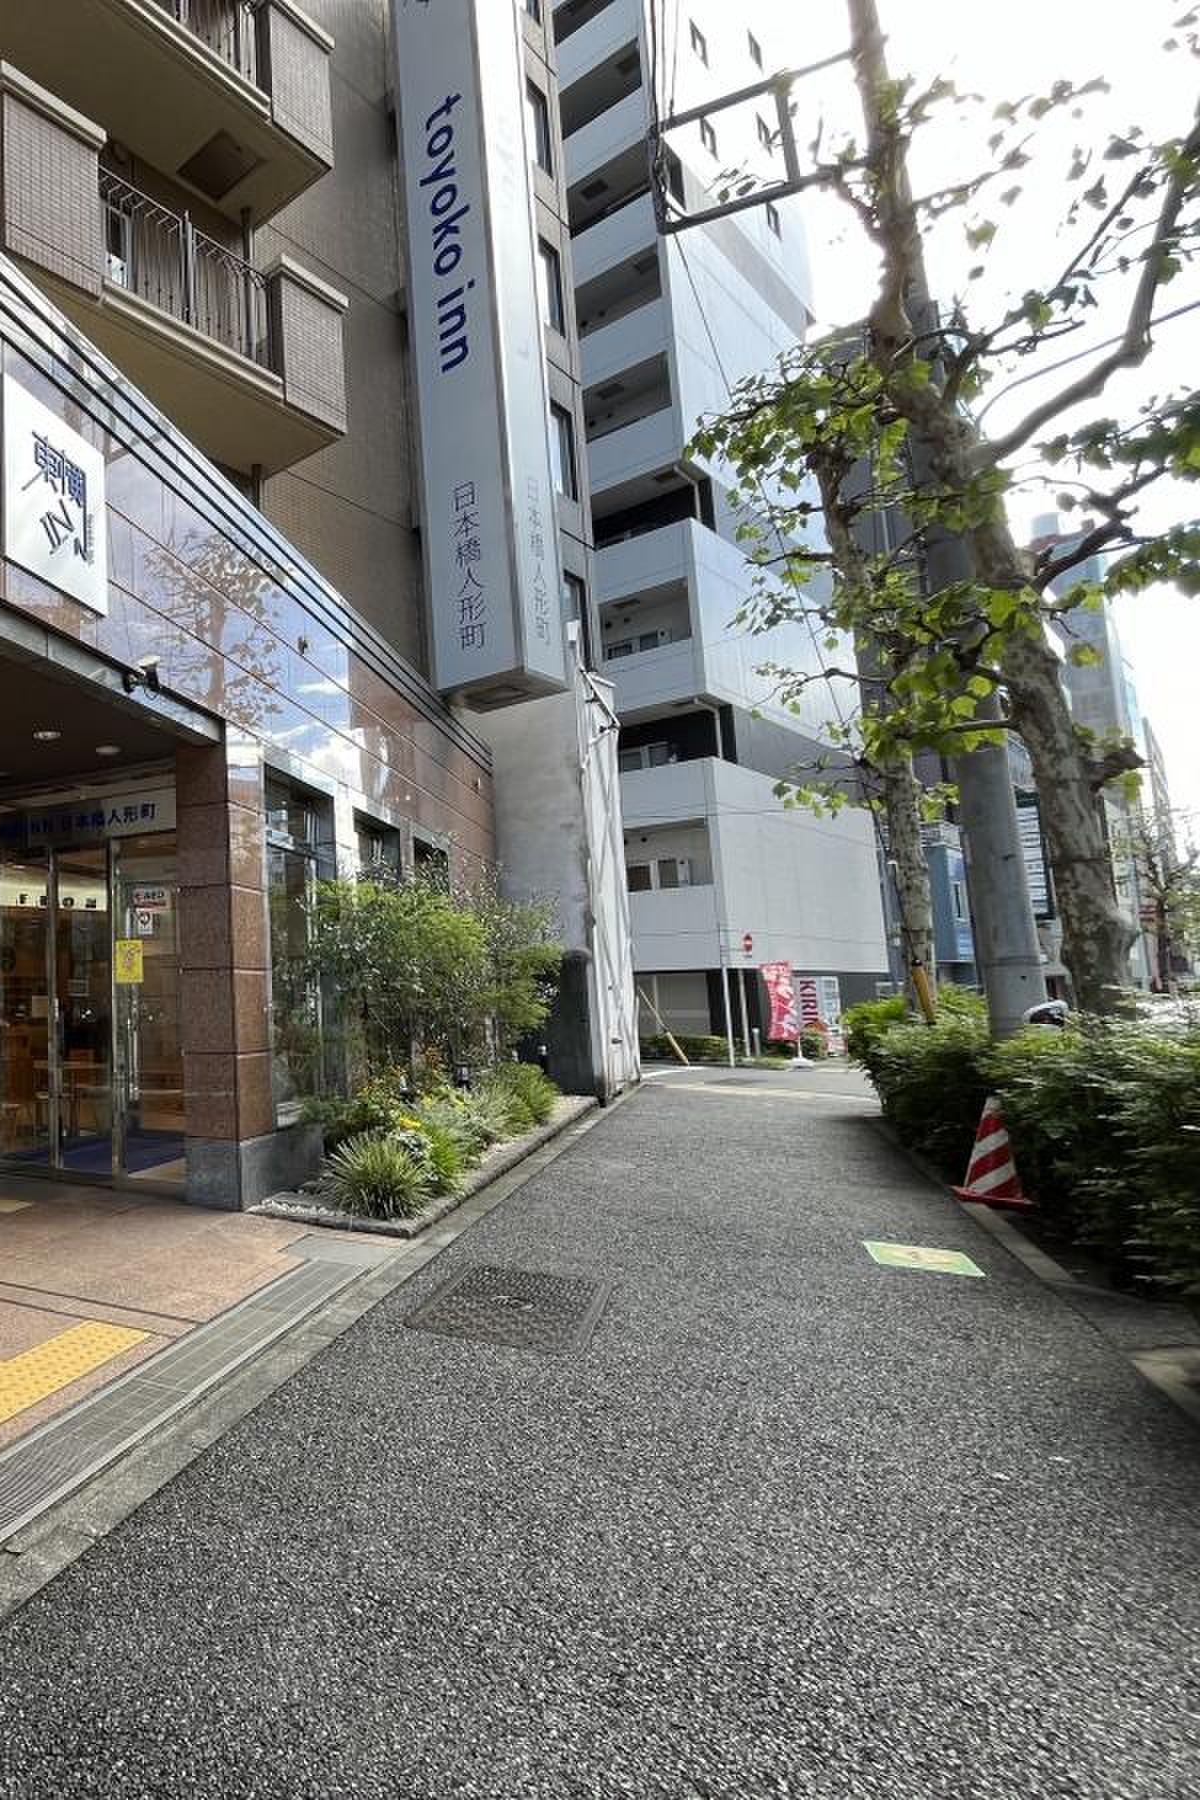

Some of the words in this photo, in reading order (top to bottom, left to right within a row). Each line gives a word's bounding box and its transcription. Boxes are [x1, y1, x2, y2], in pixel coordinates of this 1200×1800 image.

[419, 93, 470, 276] toyoko
[436, 279, 475, 373] inn
[454, 481, 487, 650] 日本橋人形町
[800, 981, 818, 1026] KIRI
